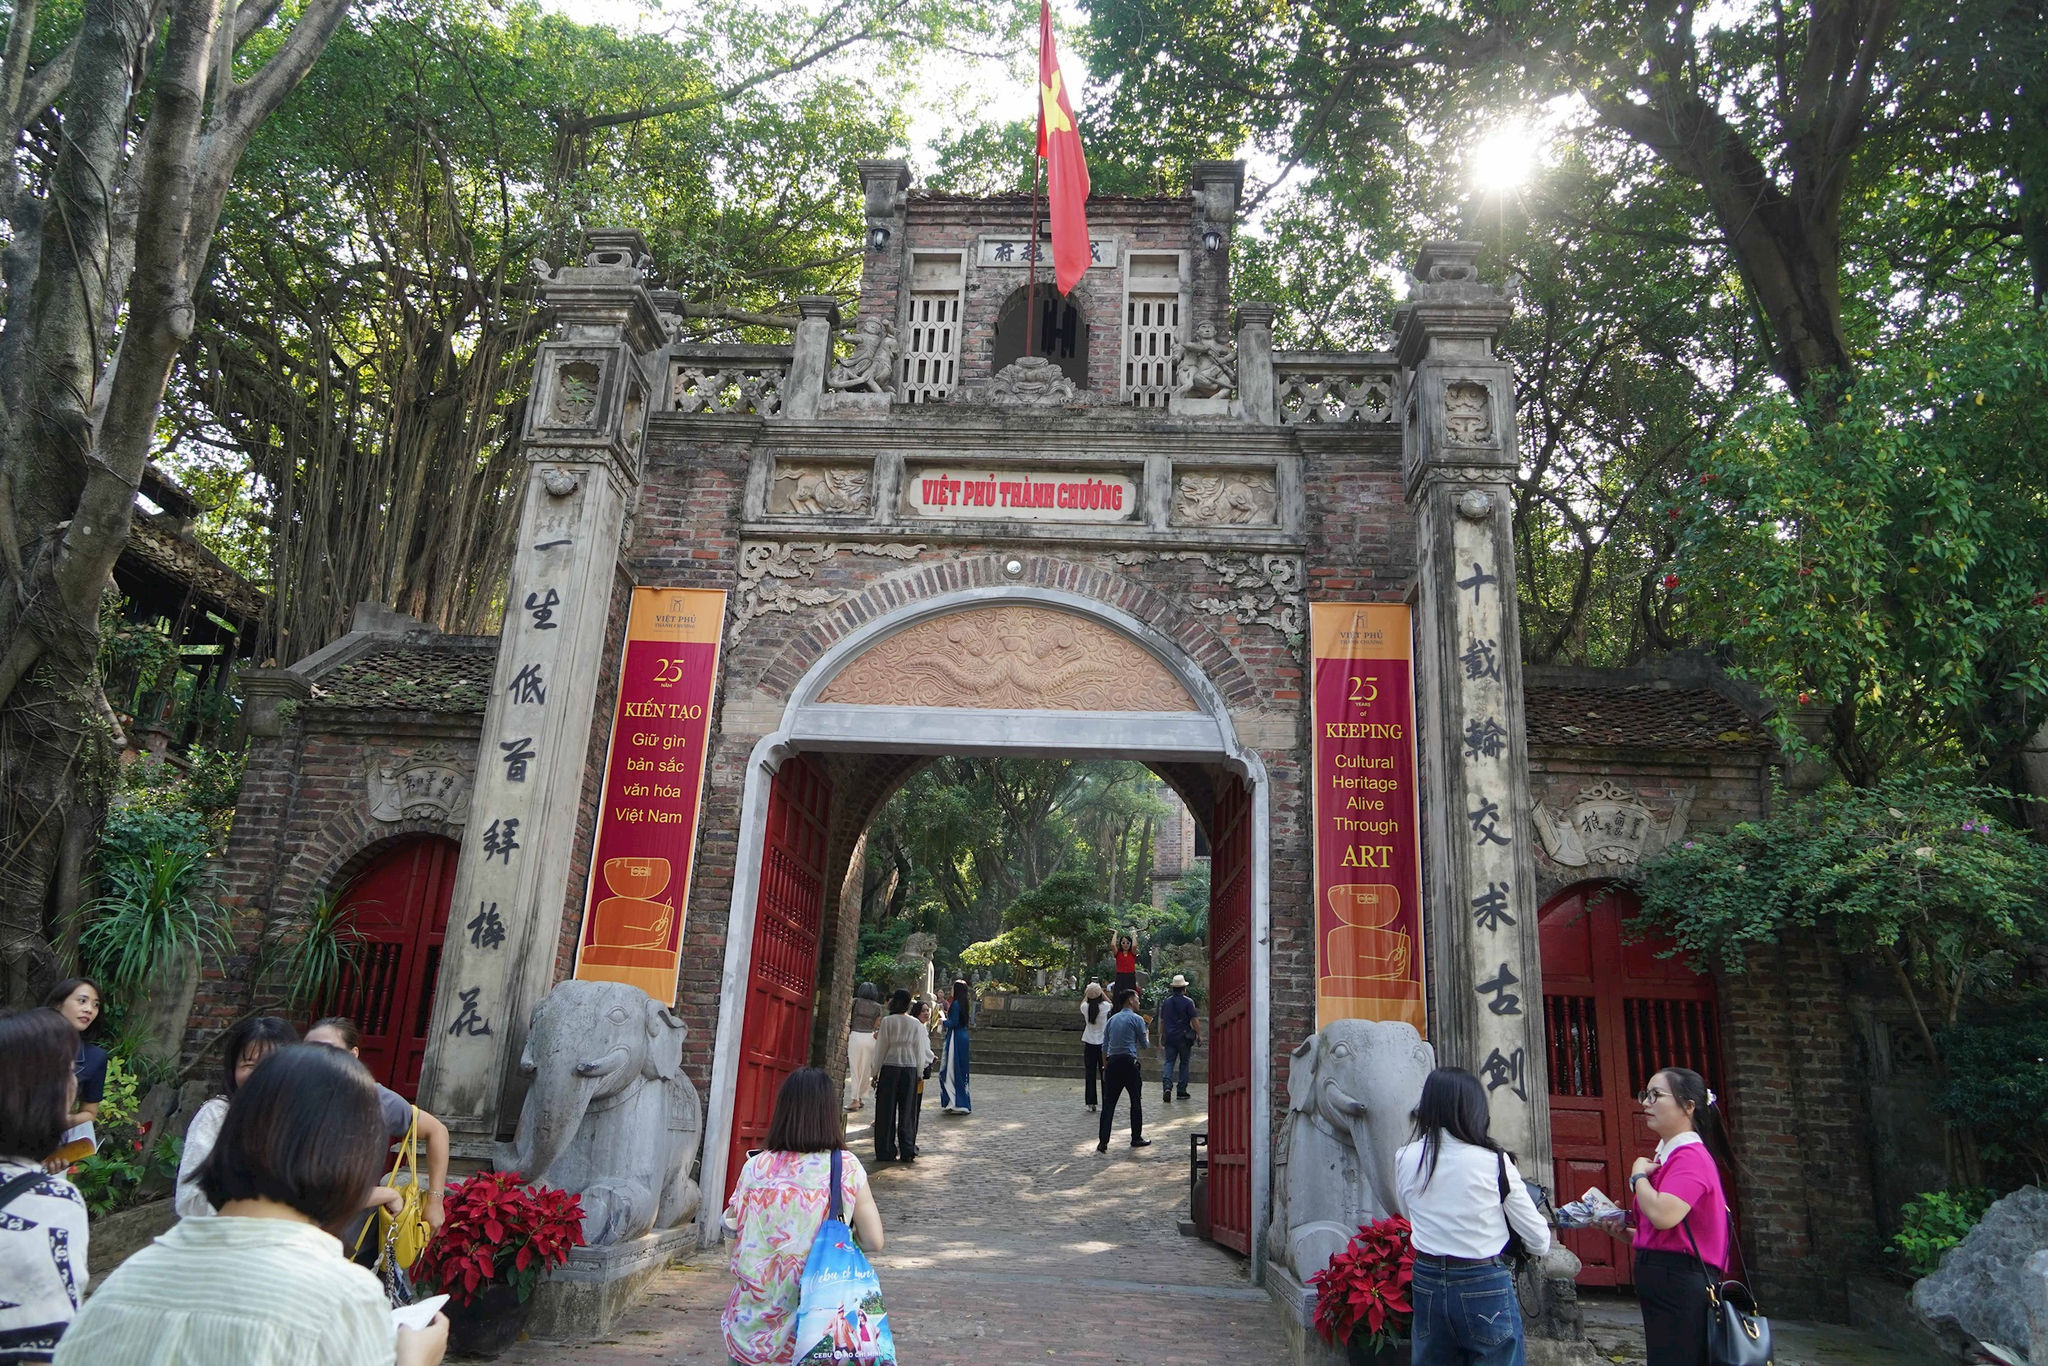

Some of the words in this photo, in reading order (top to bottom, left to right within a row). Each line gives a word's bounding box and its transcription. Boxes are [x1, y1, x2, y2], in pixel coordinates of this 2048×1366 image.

[922, 474, 961, 512] VIỆT
[963, 473, 996, 507] PHỦ
[999, 476, 1055, 509] THÀNH
[1057, 478, 1123, 511] CHƯƠNG
[678, 613, 697, 624] PHỦ
[1364, 629, 1383, 639] PHỦ
[653, 658, 685, 683] 25
[1348, 676, 1378, 701] 25
[624, 697, 665, 719] KIẾN
[668, 703, 702, 722] TẠO
[1326, 723, 1403, 740] KEEPING
[632, 732, 659, 747] Giữ
[662, 735, 686, 751] gìn
[627, 756, 654, 772] bản
[658, 757, 685, 773] sắc
[1334, 754, 1394, 769] Cultural
[623, 783, 649, 797] văn
[653, 783, 681, 798] hóa
[1332, 776, 1398, 794] Heritage
[1346, 796, 1385, 811] Alive
[615, 808, 644, 824] Việt
[647, 808, 682, 824] Nam
[1332, 817, 1398, 835] Through
[1341, 845, 1393, 868] ART
